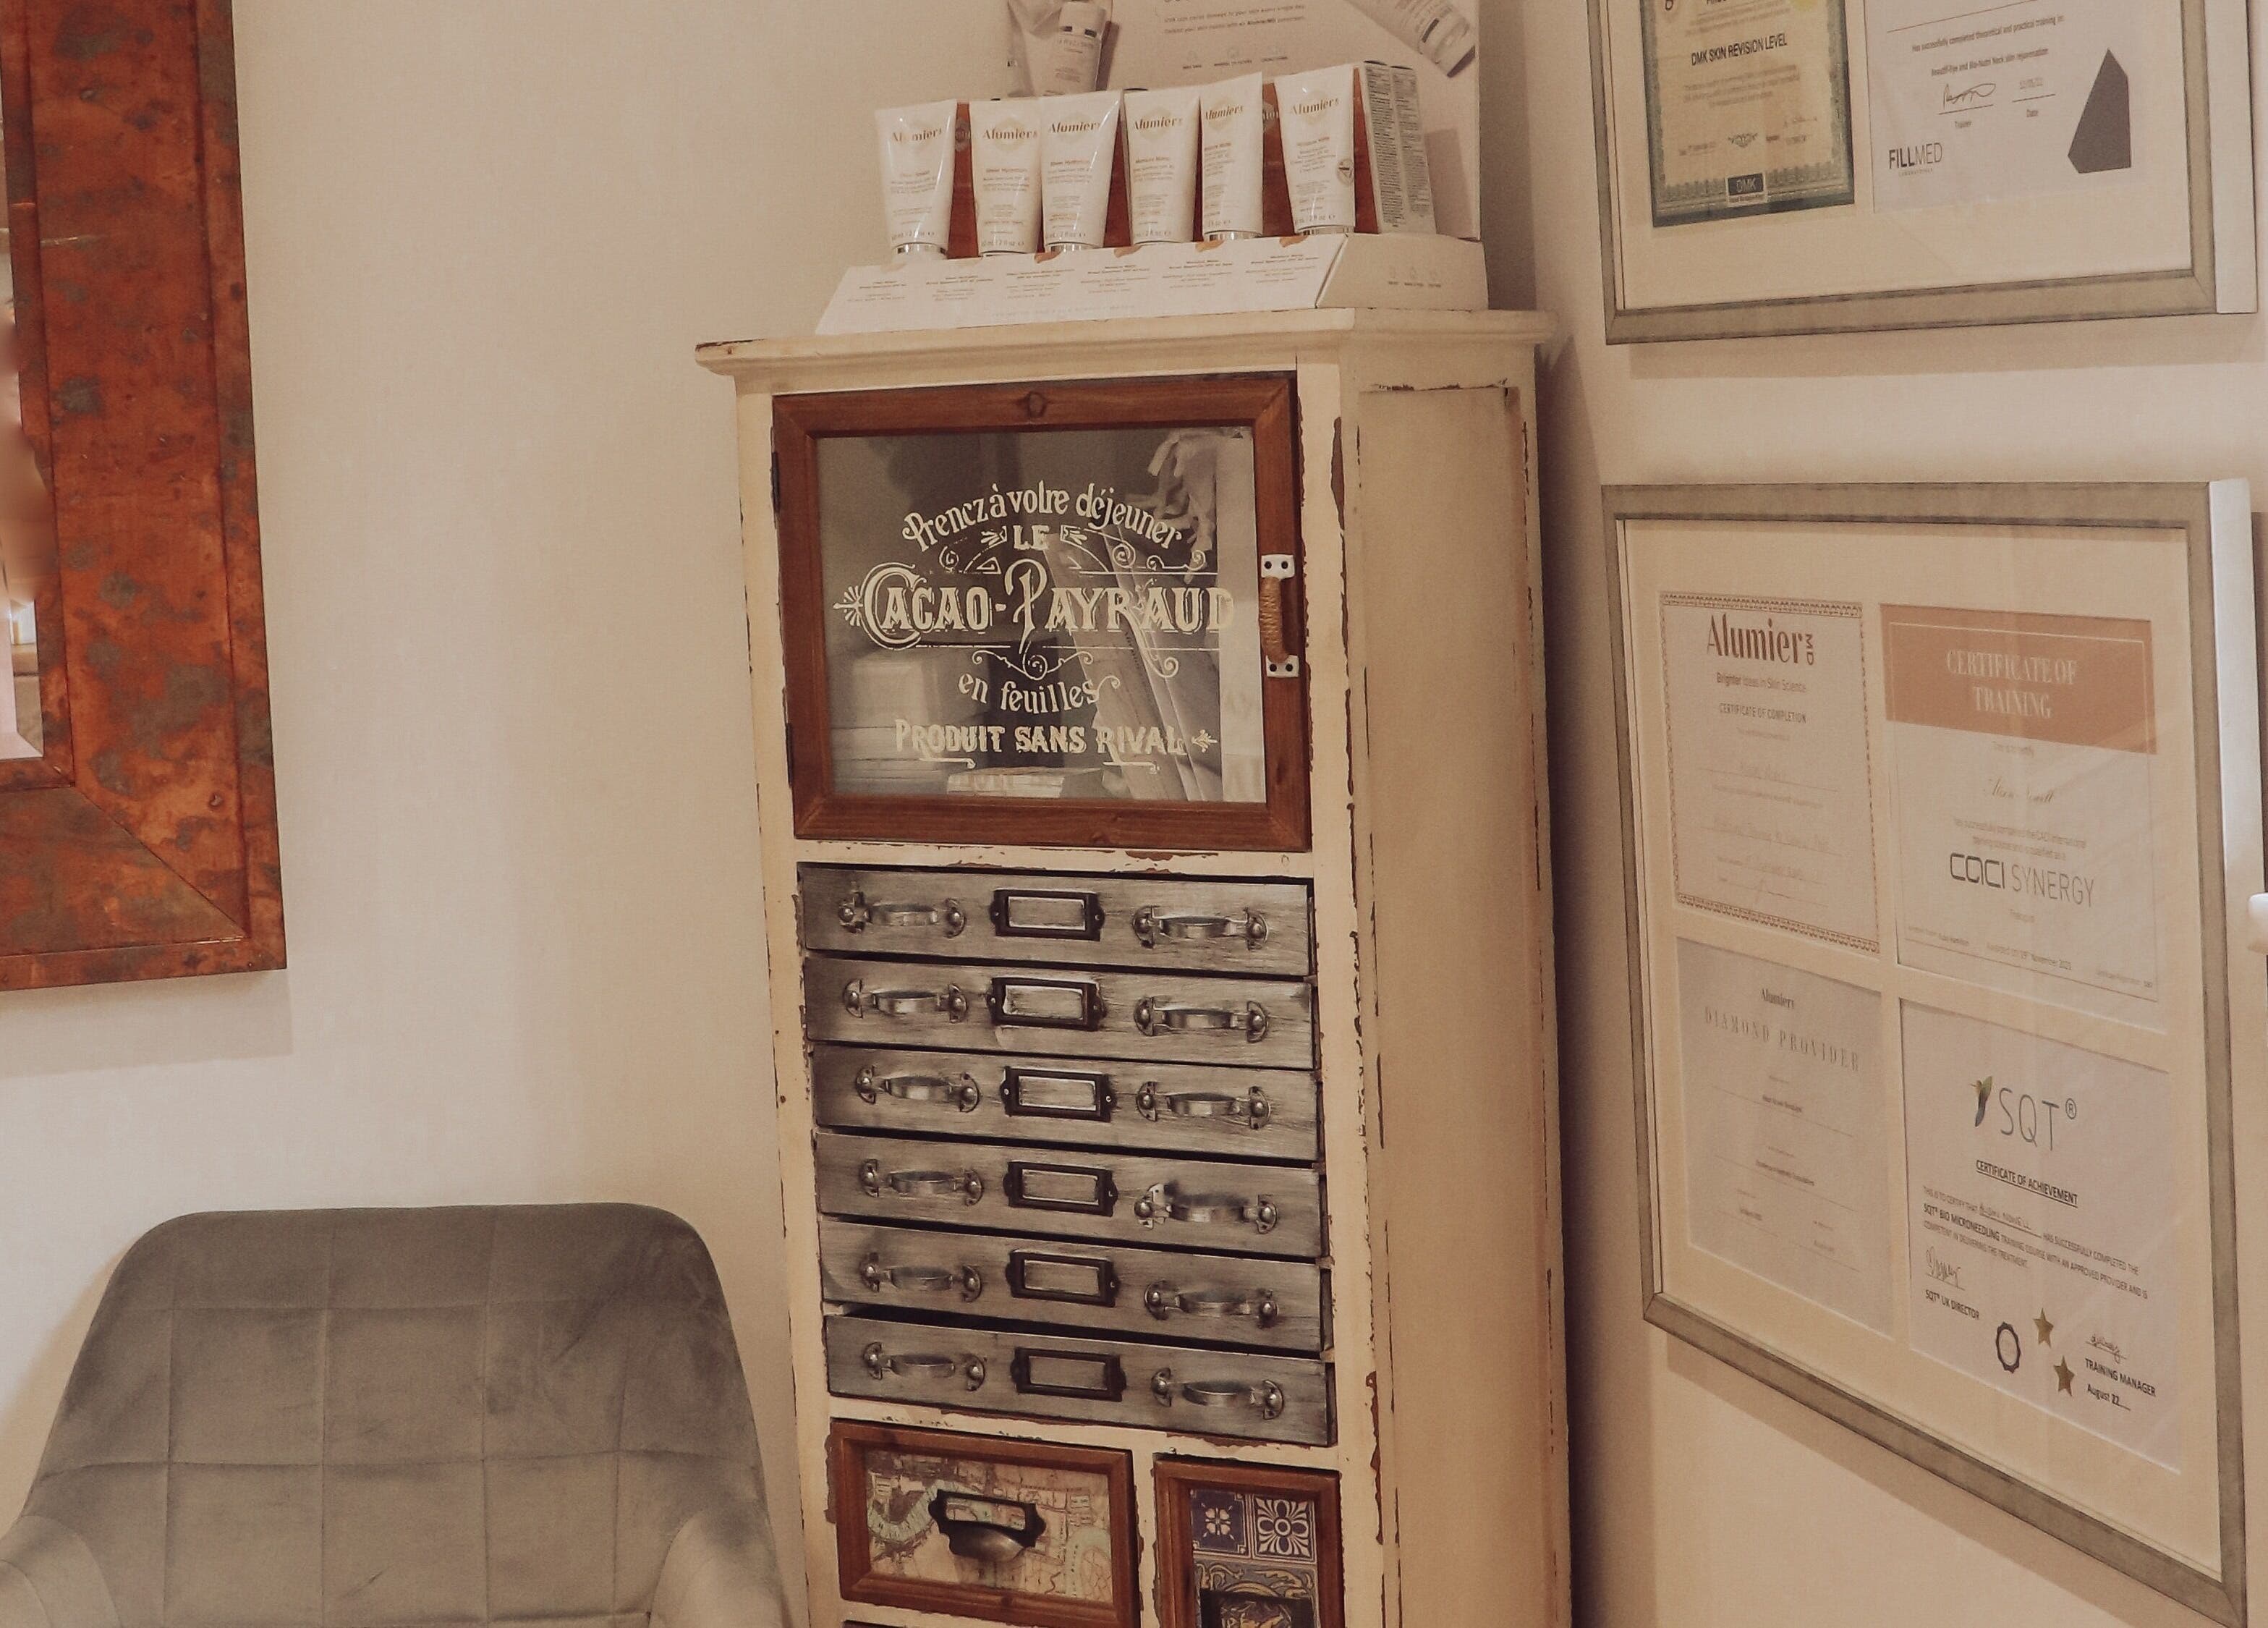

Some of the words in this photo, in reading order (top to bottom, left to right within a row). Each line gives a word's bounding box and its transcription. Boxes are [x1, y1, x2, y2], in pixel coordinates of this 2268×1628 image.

[1691, 51, 1709, 66] DMK
[1709, 47, 1727, 62] SKIN
[1728, 38, 1763, 59] REVISION
[1764, 33, 1788, 50] LEVEL
[892, 127, 938, 143] Almier
[982, 127, 1034, 140] Alumier
[1889, 142, 1943, 169] FILLMED
[1006, 480, 1069, 514] votre
[1075, 483, 1182, 550] déjeuner
[1013, 524, 1050, 551] LE
[1707, 613, 1802, 664] Alumier
[1947, 648, 2050, 684] CERTIFICATE
[2054, 659, 2078, 684] OF
[958, 671, 988, 702] en
[999, 674, 1107, 714] feuilles
[1973, 686, 2052, 719] TRAINING
[895, 718, 1005, 755] PRODUIT
[1014, 725, 1087, 754] SANS
[1097, 724, 1186, 760] RIVAL
[2010, 863, 2095, 907] SYNERGY
[1704, 1006, 1770, 1044] DIAMOND
[1778, 1028, 1859, 1072] PROVIDER
[1976, 1158, 2016, 1184] CERTIFICATE
[2017, 1174, 2027, 1187] OF
[2028, 1178, 2078, 1205] ACHIEVEMENT
[1941, 1295, 1951, 1307] UK
[1951, 1300, 1980, 1320] DIRECTOR
[2085, 1357, 2119, 1382] TRAINING
[2120, 1373, 2157, 1397] MANAGER
